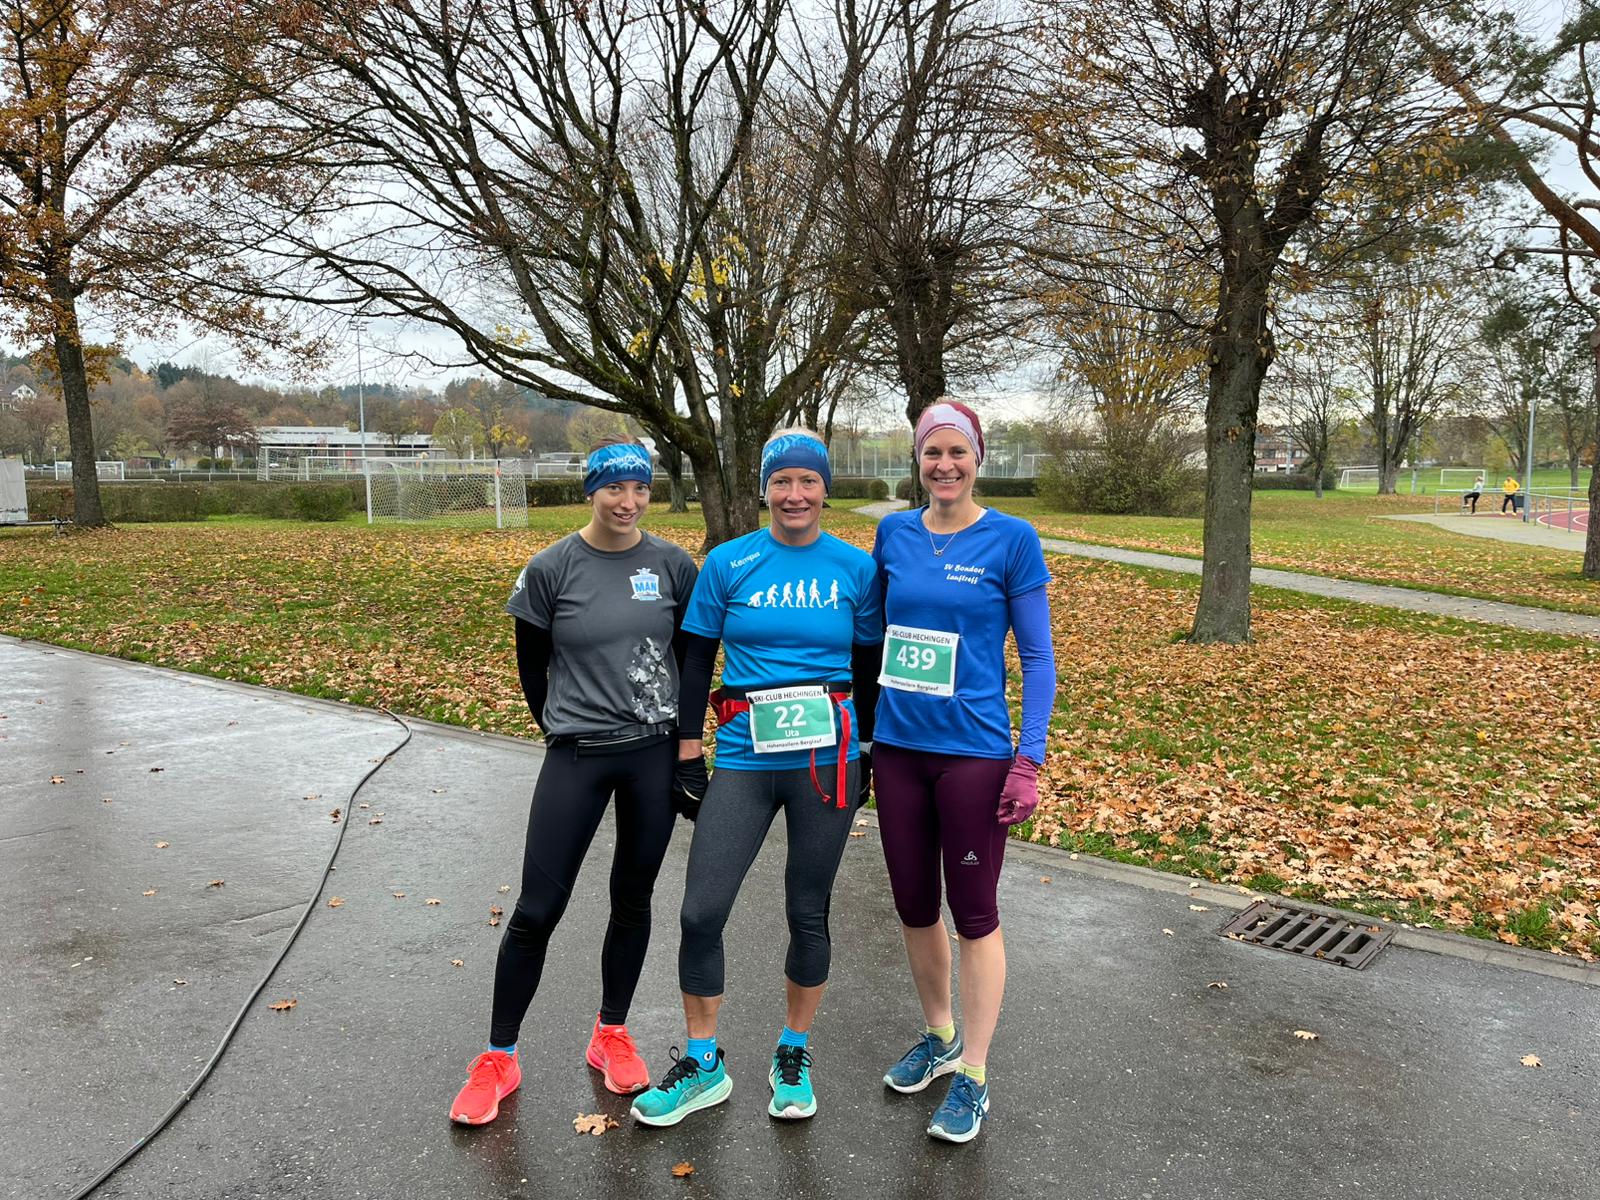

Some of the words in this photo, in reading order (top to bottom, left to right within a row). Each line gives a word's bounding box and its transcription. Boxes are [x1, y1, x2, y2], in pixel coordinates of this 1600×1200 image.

[730, 552, 760, 568] Kempa
[954, 564, 985, 575] Bondorf
[946, 574, 978, 584] Lauftreff
[635, 582, 657, 592] MAN
[913, 633, 950, 644] HECHINGEN
[896, 645, 937, 670] 439
[754, 693, 782, 702] SKI-CLUB
[784, 690, 822, 698] HECHINGEN
[774, 704, 806, 729] 22
[785, 729, 799, 737] Uta
